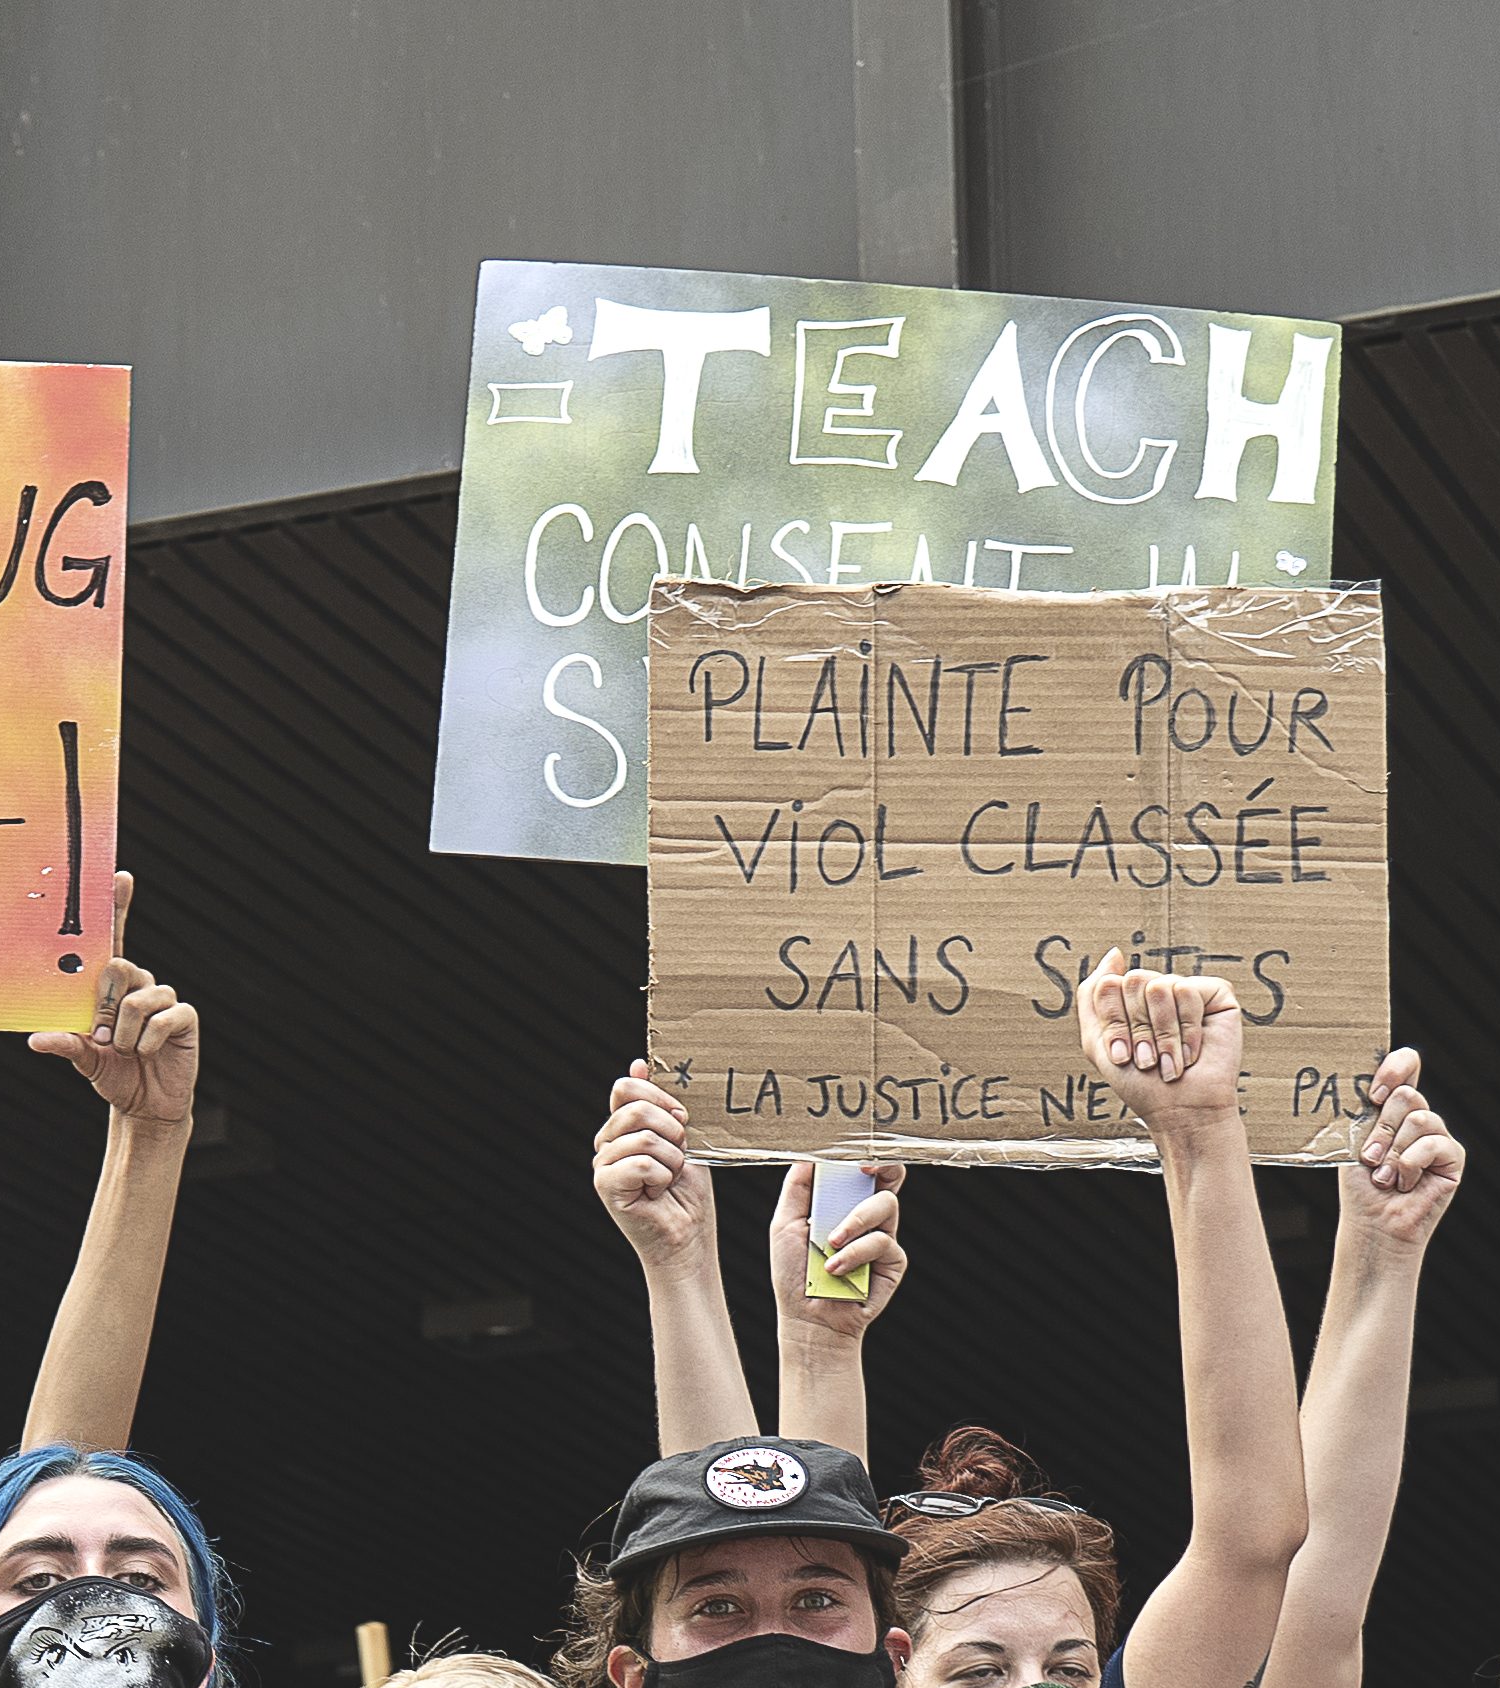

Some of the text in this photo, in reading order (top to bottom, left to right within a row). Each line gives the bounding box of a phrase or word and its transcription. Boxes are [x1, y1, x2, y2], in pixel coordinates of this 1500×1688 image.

[587, 295, 1336, 506] TEACH
[1119, 652, 1334, 758] POUR
[960, 777, 1333, 890] CLASSÉE
[764, 933, 975, 1016] SANS
[723, 1066, 782, 1118] LA
